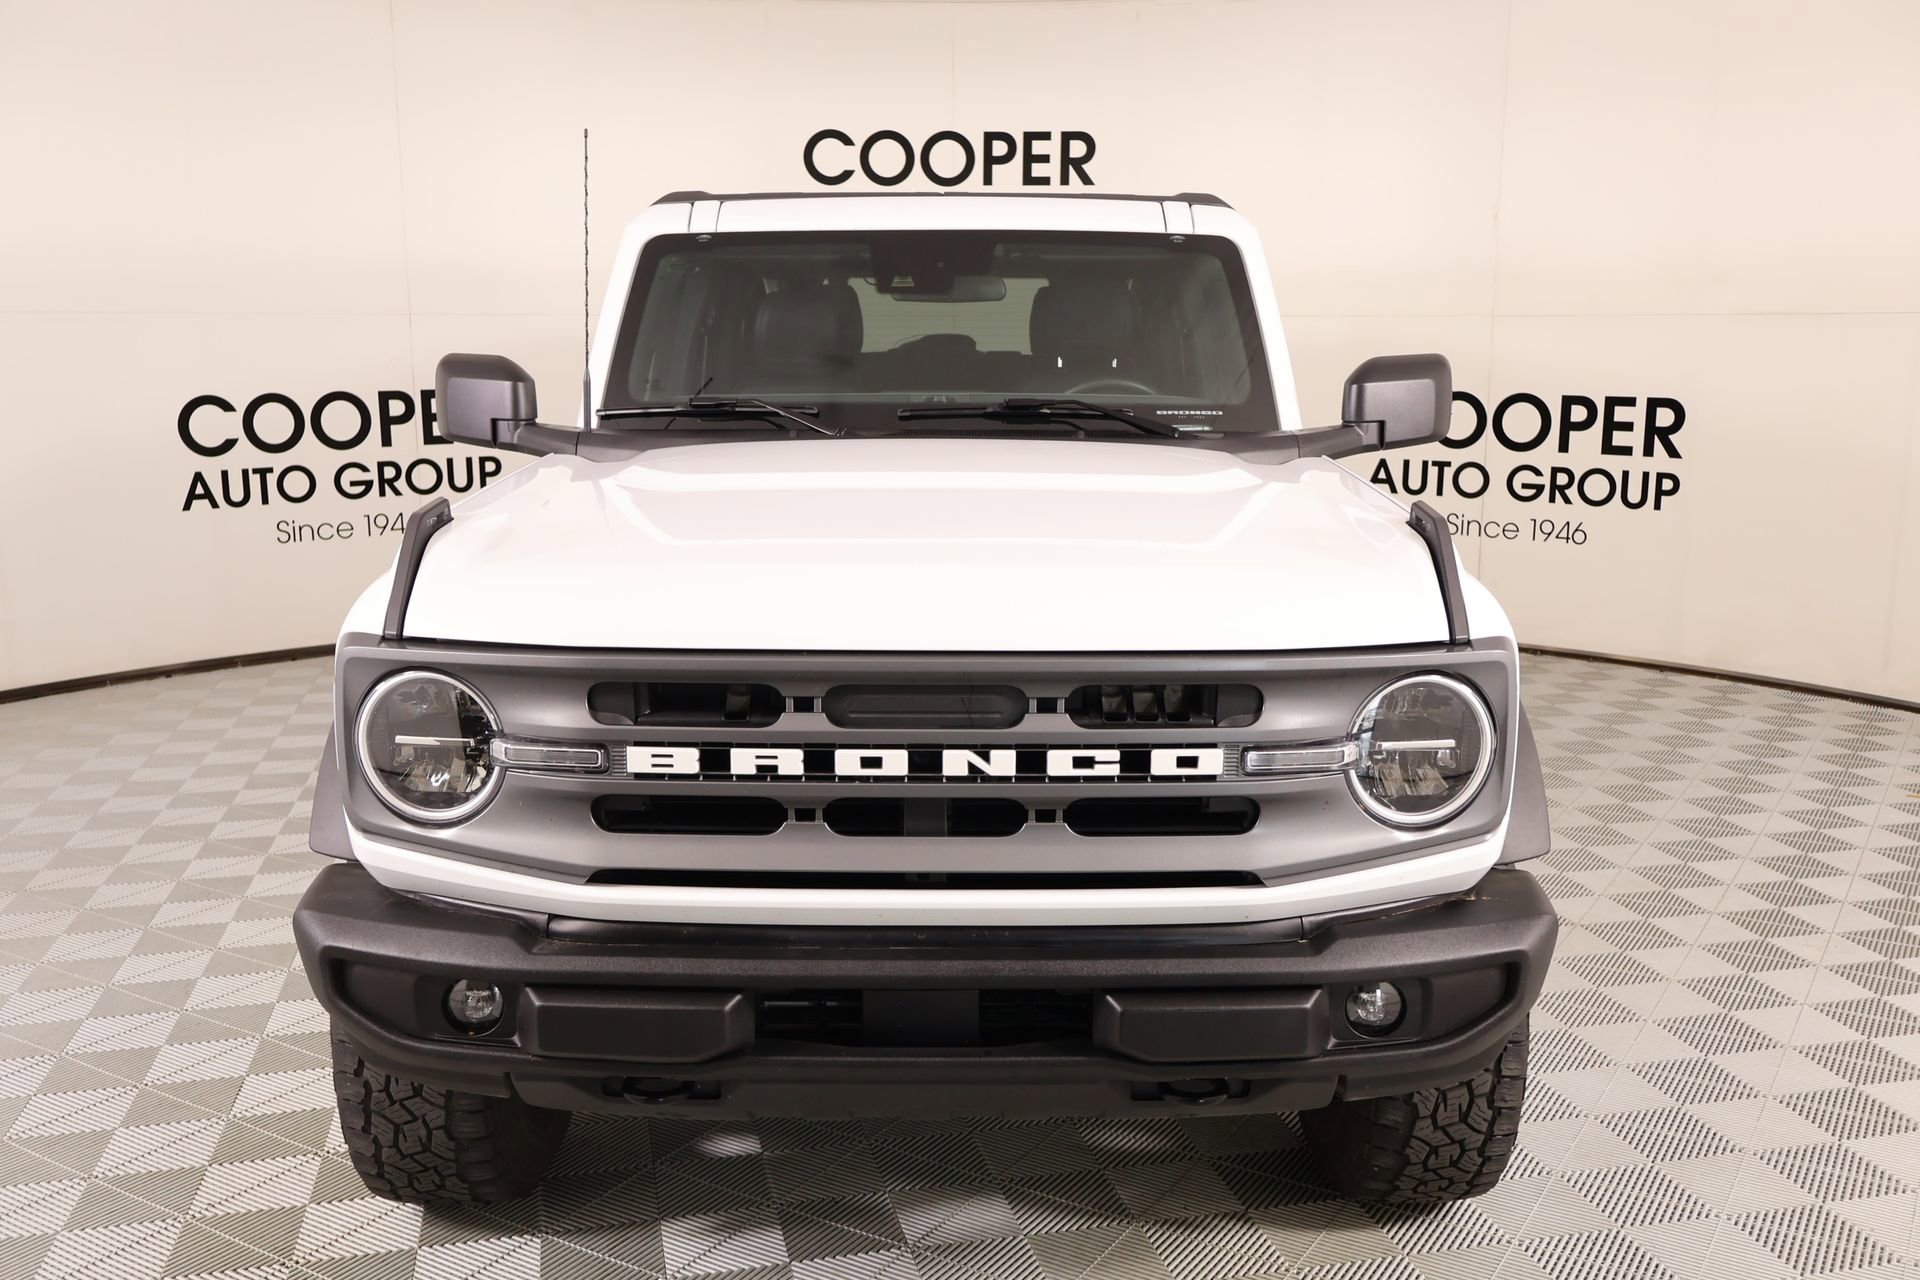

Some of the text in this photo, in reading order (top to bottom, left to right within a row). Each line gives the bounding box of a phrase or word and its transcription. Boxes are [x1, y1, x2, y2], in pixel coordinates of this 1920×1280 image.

[803, 129, 1096, 187] COOPER
[177, 389, 454, 457] COOPE
[1437, 390, 1686, 459] OOPER
[182, 456, 502, 511] AUTO GROUP
[1370, 458, 1680, 511] AUTO GROUP
[276, 512, 405, 544] Since 194
[1446, 513, 1587, 545] Since 1946
[626, 745, 1224, 778] BRONCO
